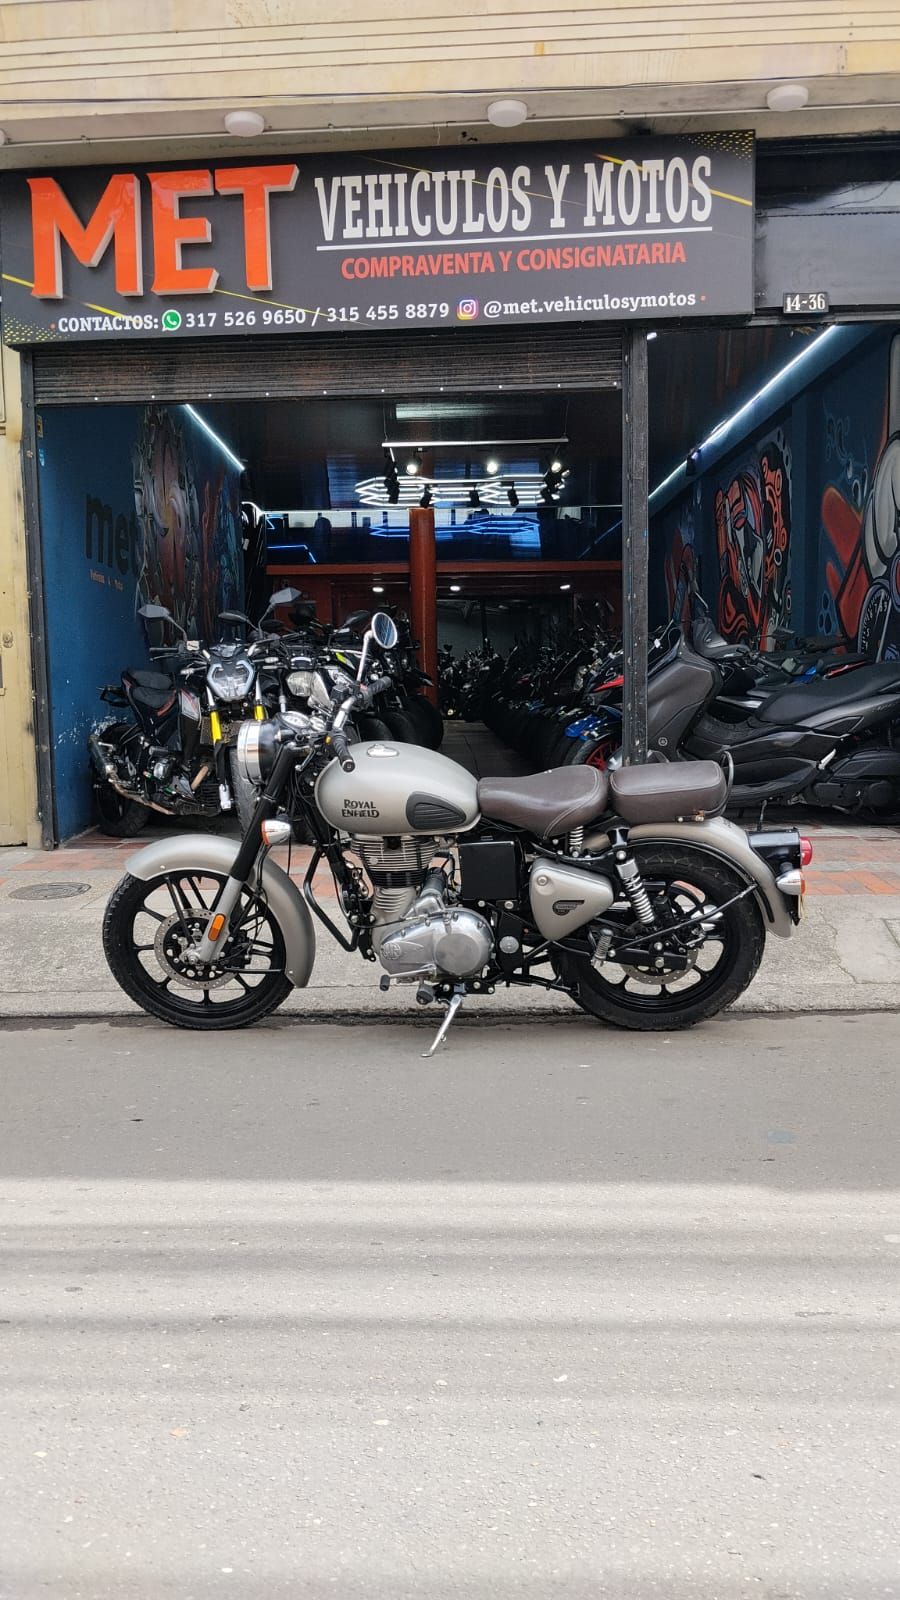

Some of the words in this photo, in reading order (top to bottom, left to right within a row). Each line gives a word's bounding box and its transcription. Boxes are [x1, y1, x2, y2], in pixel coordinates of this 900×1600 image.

[314, 165, 532, 241] VEHICULOS
[544, 164, 570, 228] Y
[584, 156, 713, 227] MOTOS
[27, 163, 299, 299] MET
[341, 251, 495, 280] COMPRAVENTA
[498, 250, 513, 272] Y
[516, 241, 687, 272] CONSIGNATARIA
[58, 314, 159, 333] CONTACTOS:
[185, 312, 217, 328] 317
[224, 311, 256, 327] 526
[262, 308, 306, 325] 9650
[311, 307, 321, 327] /
[327, 306, 360, 322] 315
[365, 304, 399, 321] 455
[405, 302, 450, 319] 8879
[483, 291, 696, 318] @met.vehiculosymotos
[786, 293, 826, 312] 14-36
[341, 808, 380, 818] ENFIELD
[343, 798, 377, 809] ROYAL
